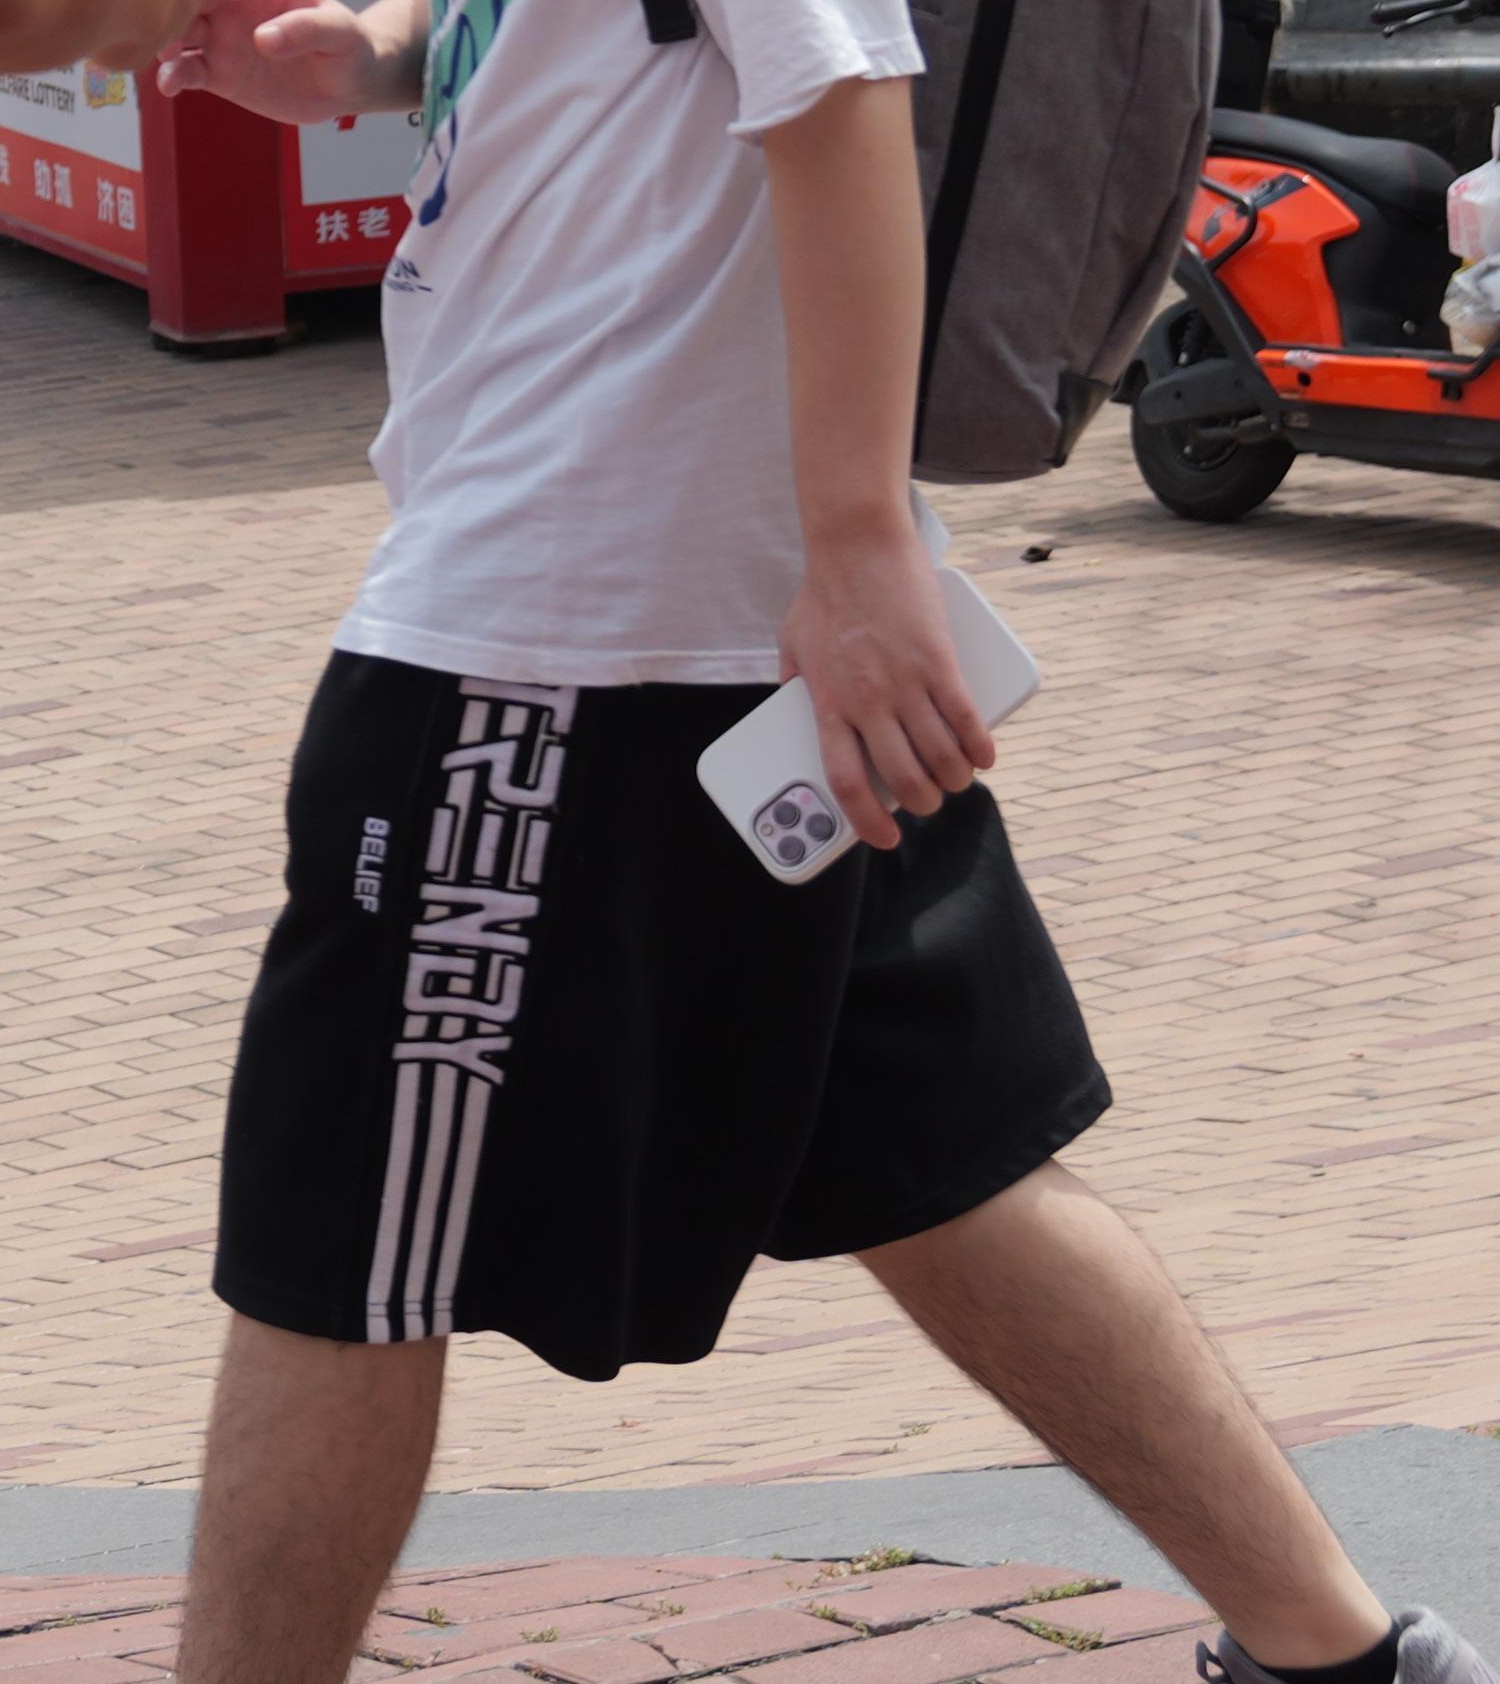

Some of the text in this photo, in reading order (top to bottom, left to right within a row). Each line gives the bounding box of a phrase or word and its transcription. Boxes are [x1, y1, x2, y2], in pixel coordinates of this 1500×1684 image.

[31, 80, 75, 114] LOTTERY
[34, 157, 74, 209] 助孤
[315, 205, 391, 244] 扶老
[353, 816, 391, 914] BELIEF
